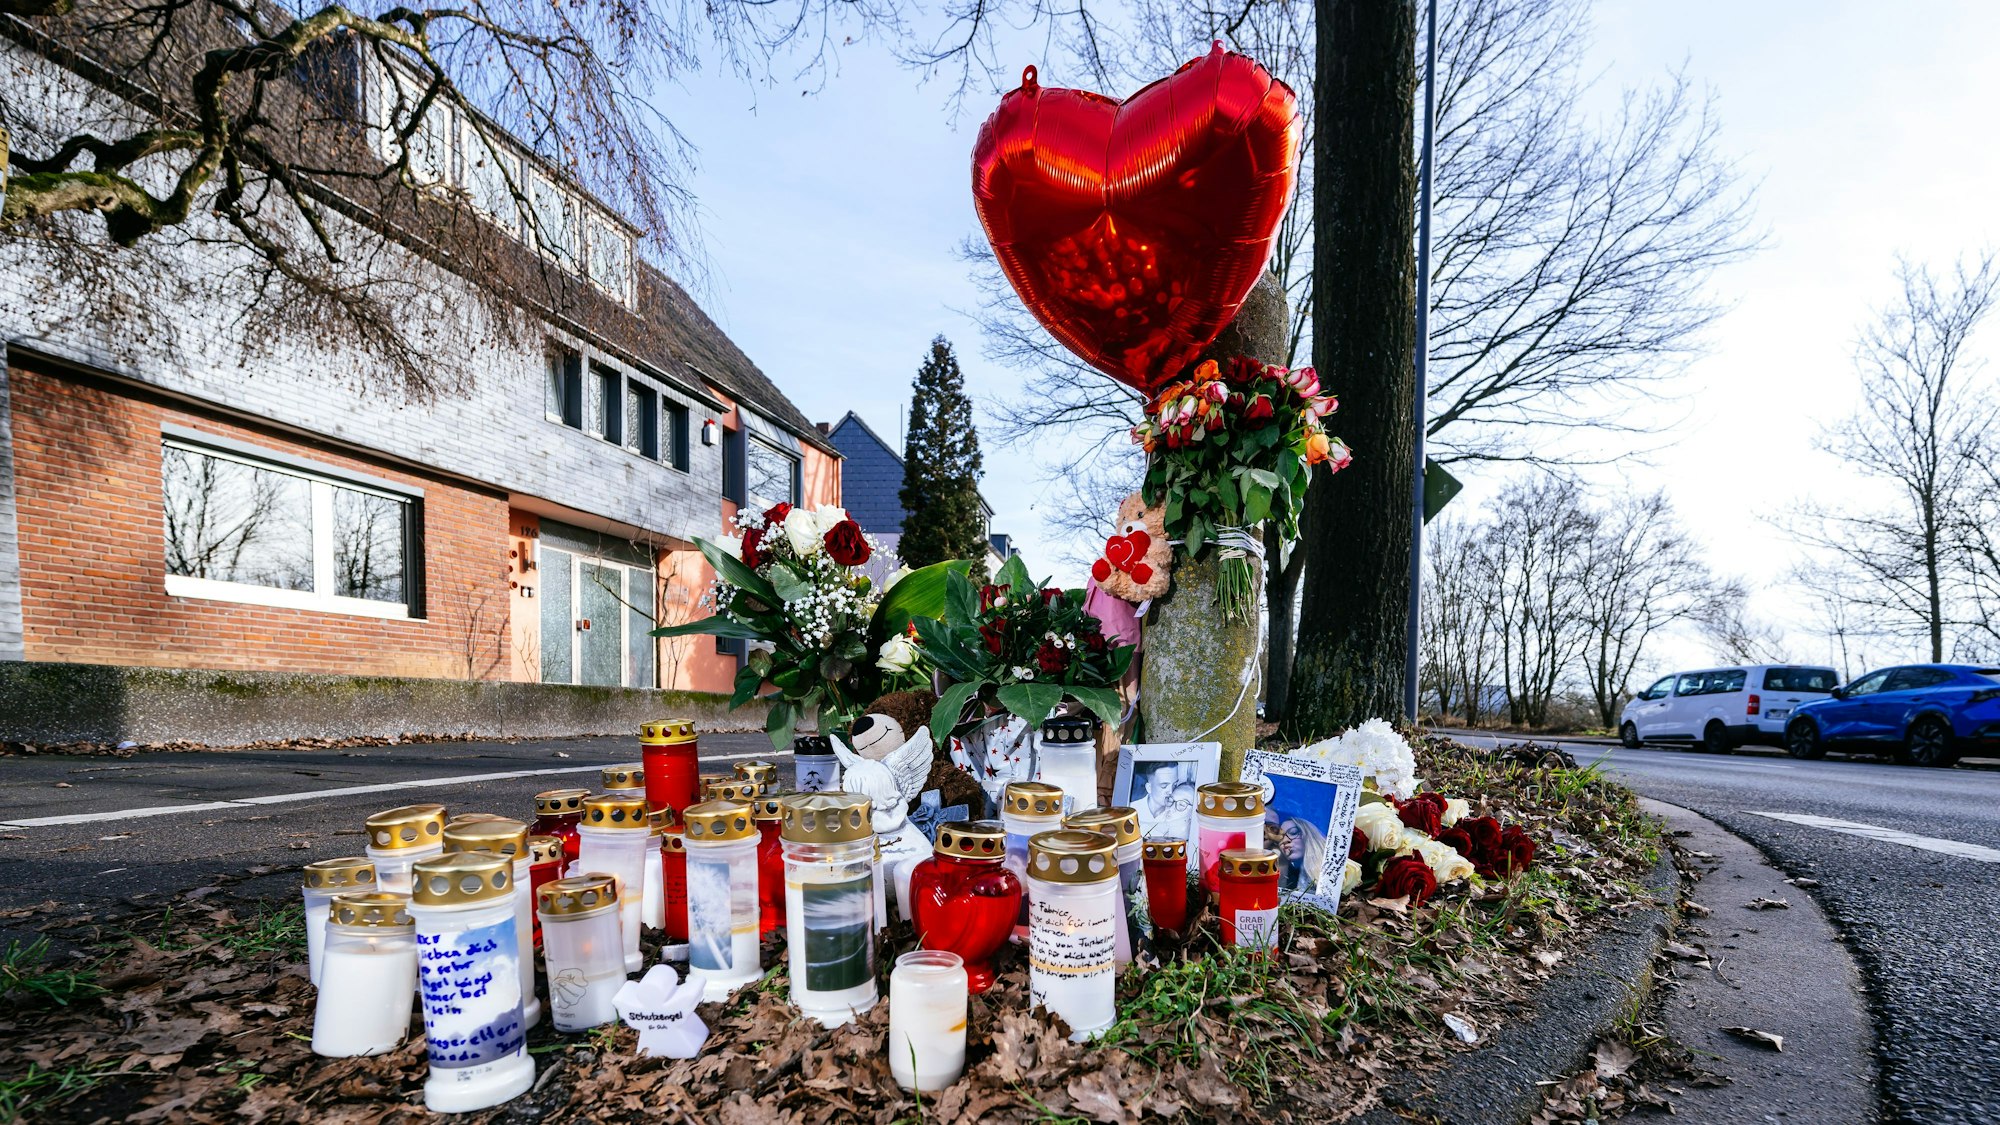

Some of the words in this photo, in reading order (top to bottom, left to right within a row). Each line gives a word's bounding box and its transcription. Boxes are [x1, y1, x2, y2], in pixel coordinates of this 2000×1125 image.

[1039, 901, 1072, 920] Fabrice,
[1045, 917, 1064, 927] dich
[1239, 916, 1265, 924] GRAB-
[1239, 923, 1264, 931] LICHT
[1064, 952, 1086, 960] dich
[629, 1011, 683, 1022] Schutzengel
